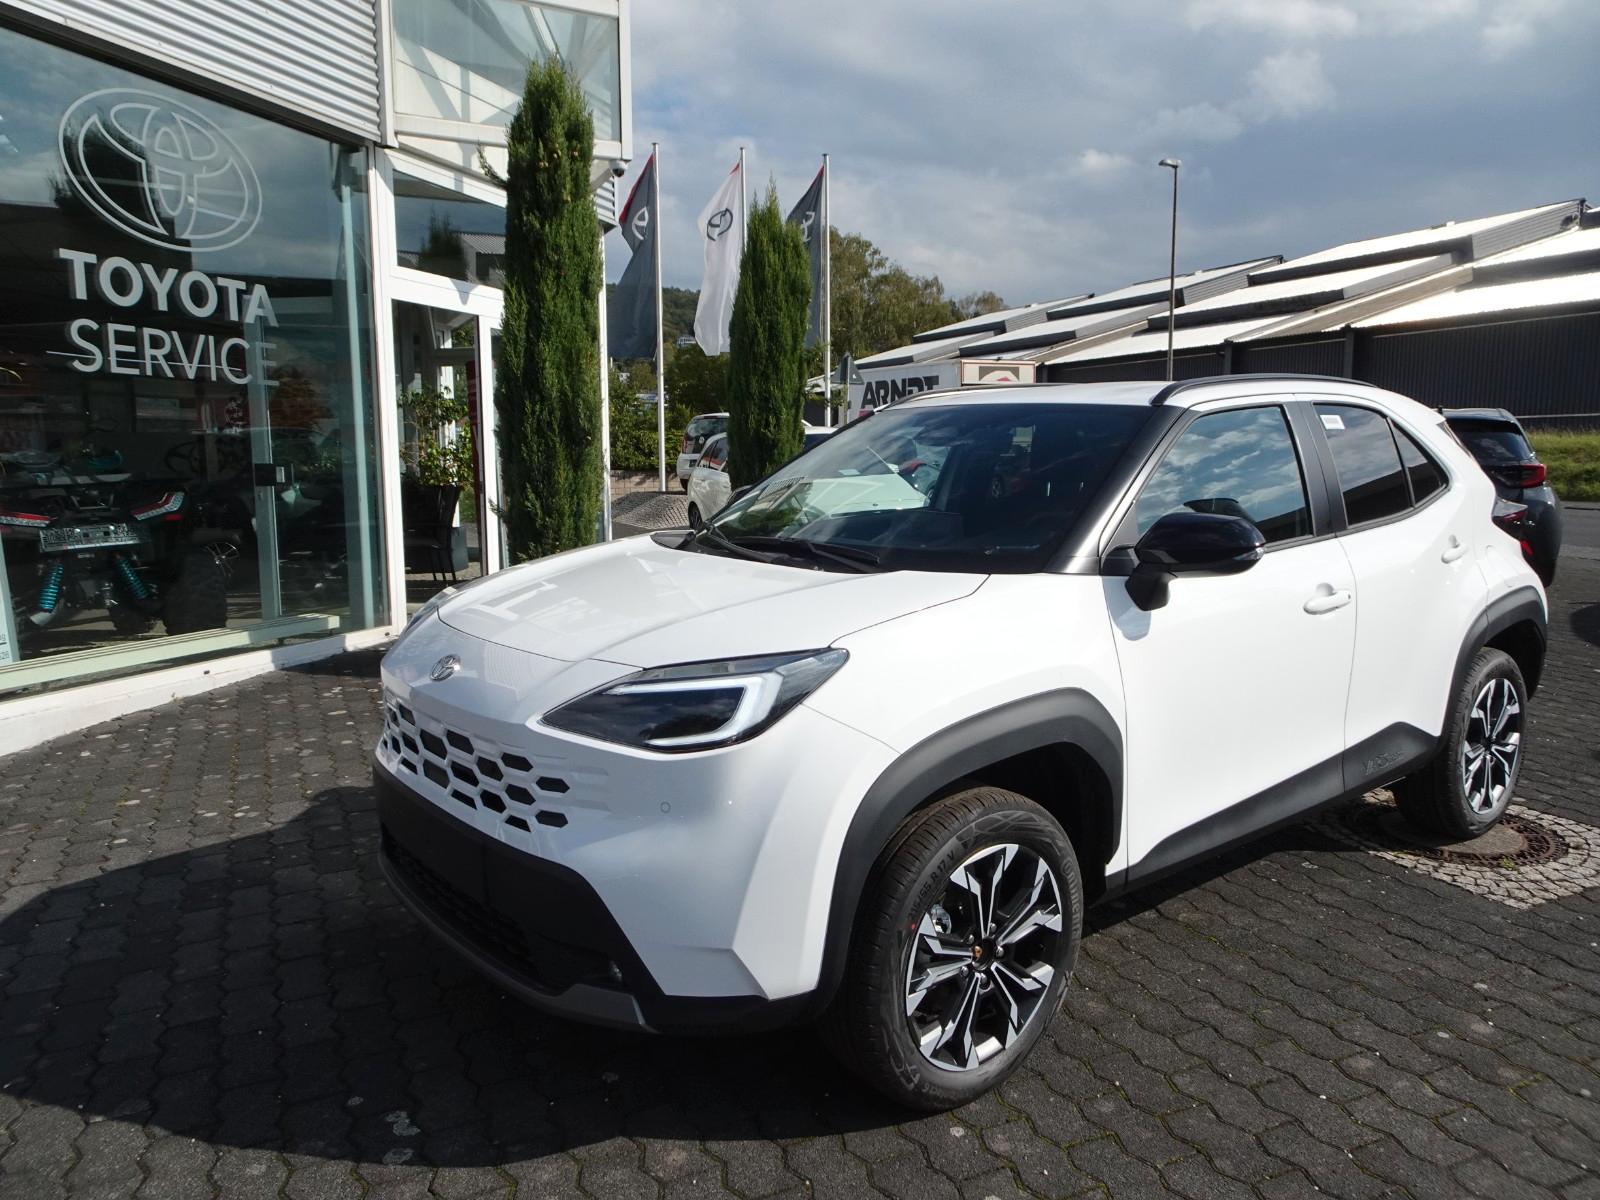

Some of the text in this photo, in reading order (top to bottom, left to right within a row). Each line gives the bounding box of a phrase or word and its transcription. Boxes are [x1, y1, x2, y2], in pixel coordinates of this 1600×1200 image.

[58, 247, 279, 327] TOYOTA
[69, 318, 280, 387] SERVICE
[860, 375, 940, 410] ARNDT
